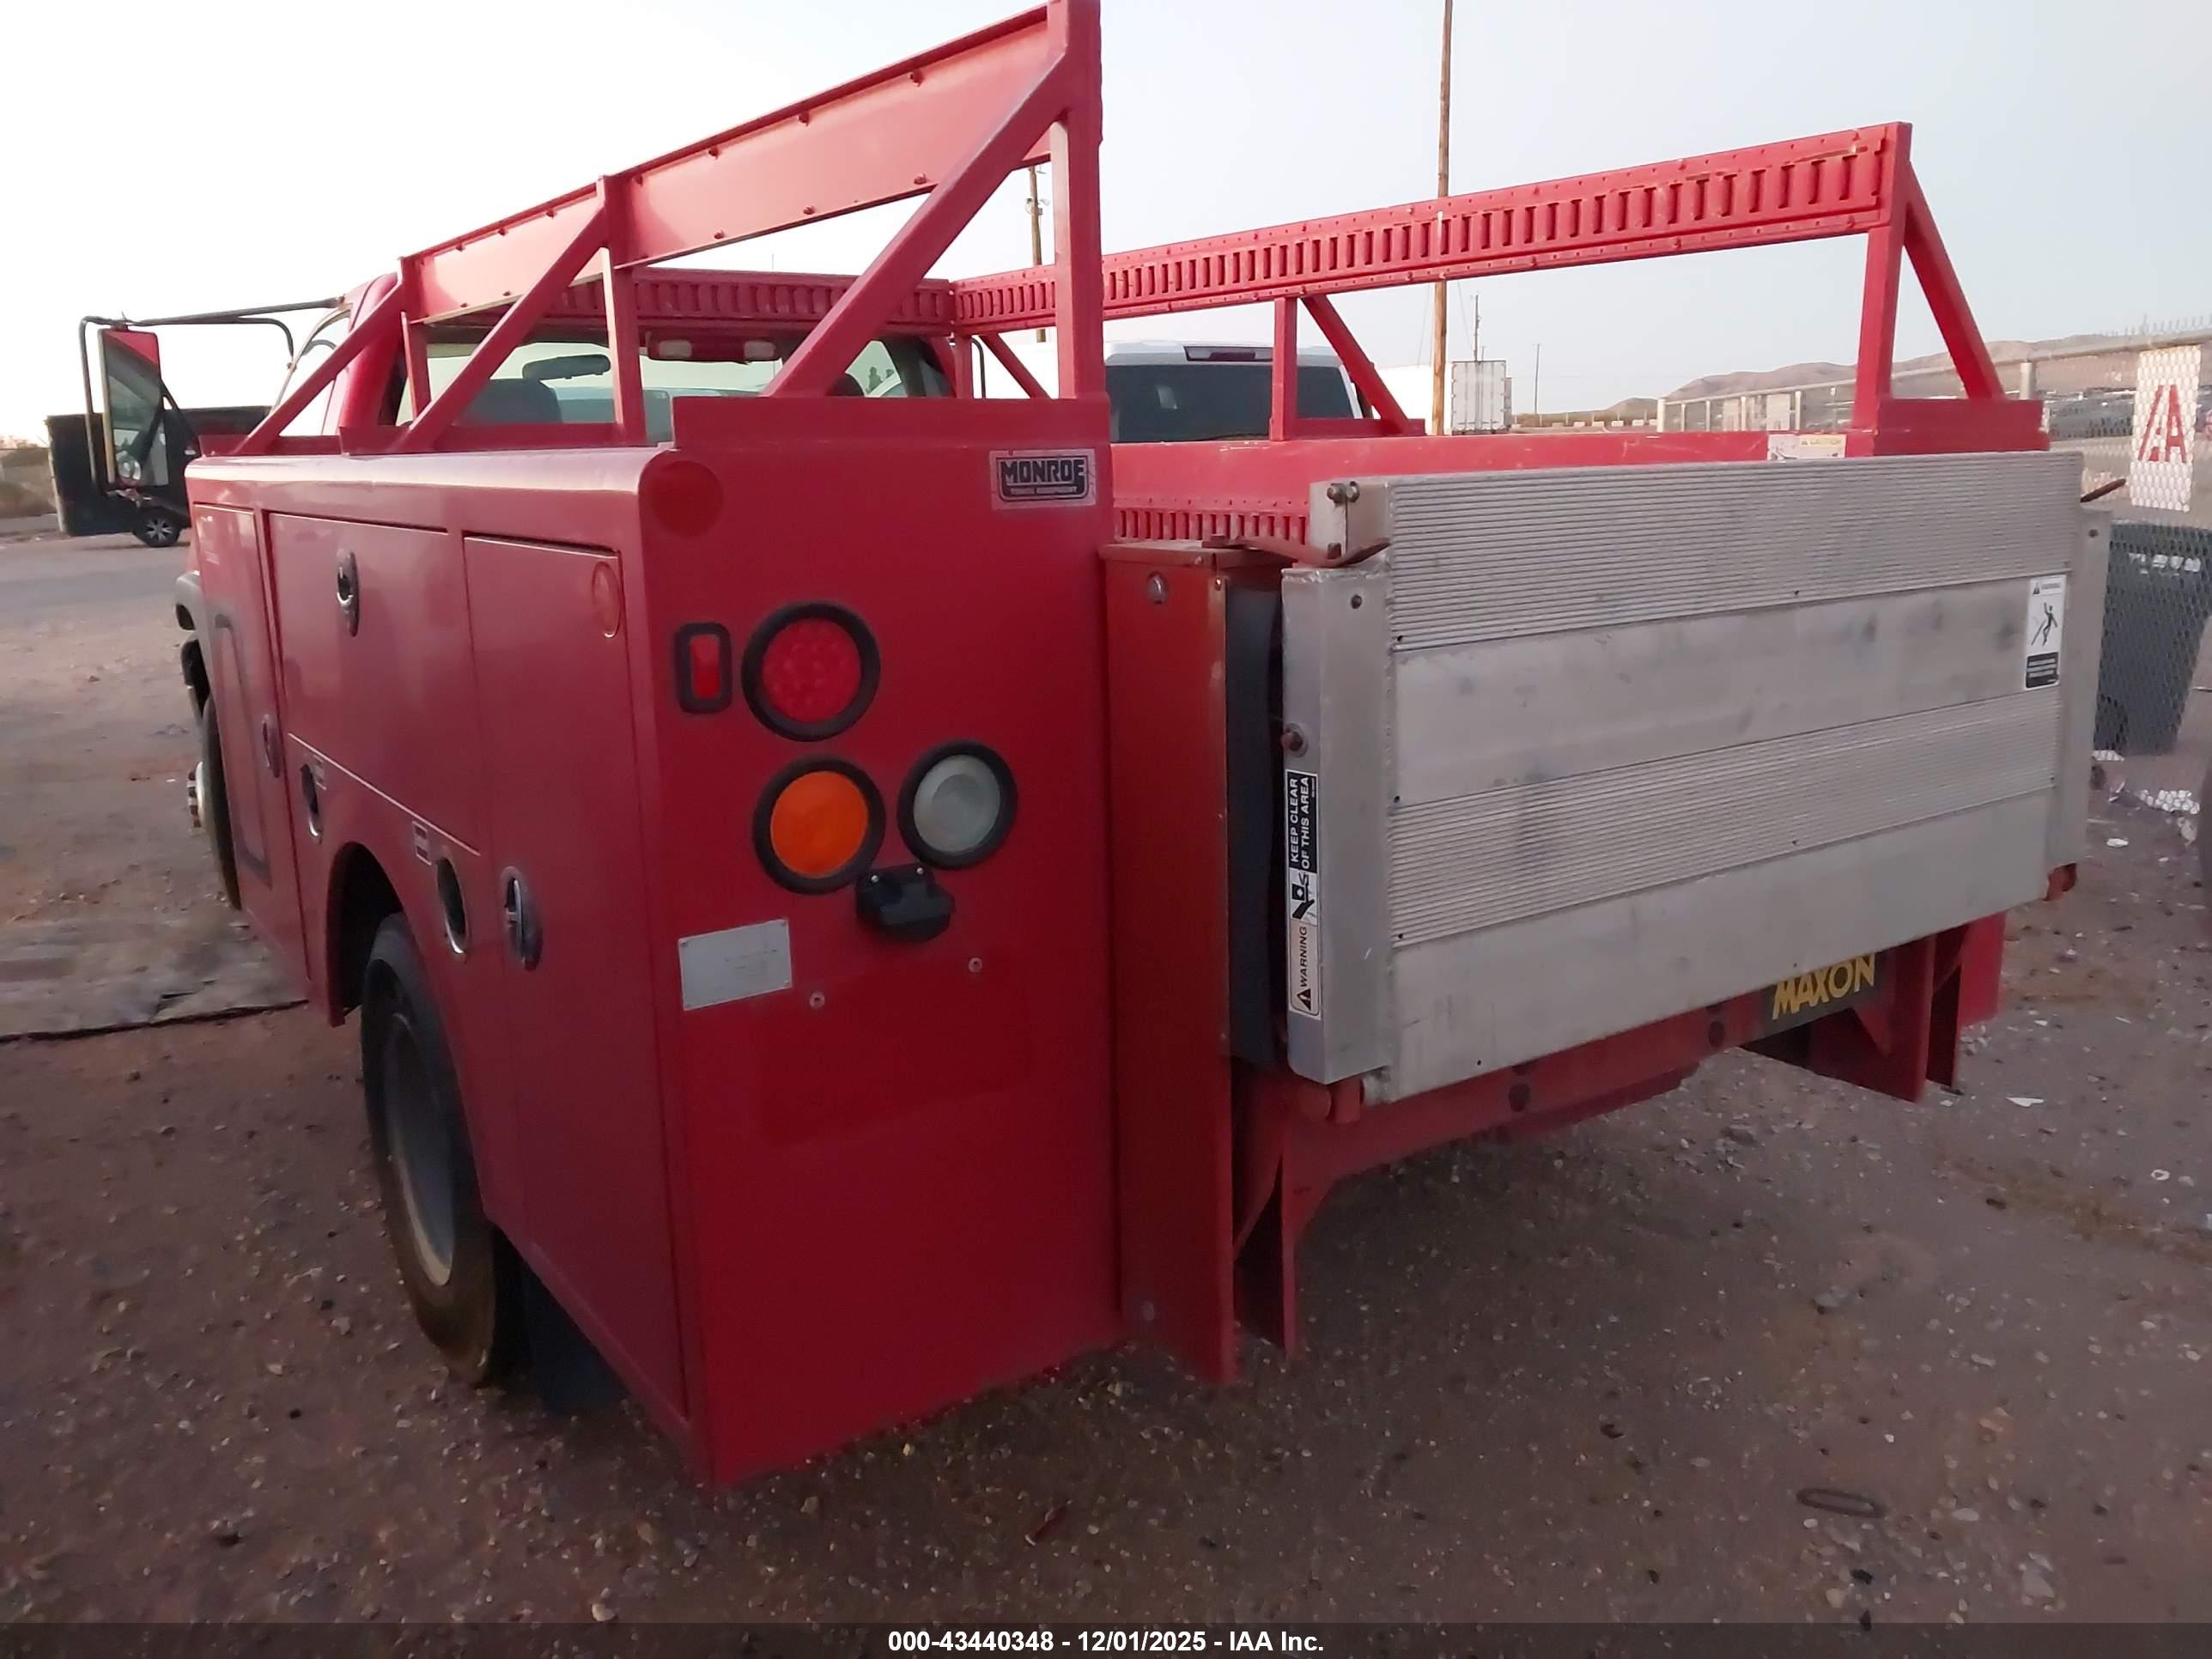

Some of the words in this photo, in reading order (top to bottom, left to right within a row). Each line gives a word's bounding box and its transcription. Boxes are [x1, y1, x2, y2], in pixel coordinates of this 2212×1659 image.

[1000, 459, 1085, 483] MONROE
[1289, 778, 1298, 823] CLEAR
[1299, 777, 1310, 816] AREA
[1291, 827, 1299, 862] KEEP
[1300, 818, 1310, 848] THIS
[1301, 851, 1310, 869] OF
[1298, 927, 1308, 987] WARNING
[1772, 953, 1875, 1020] MAXON
